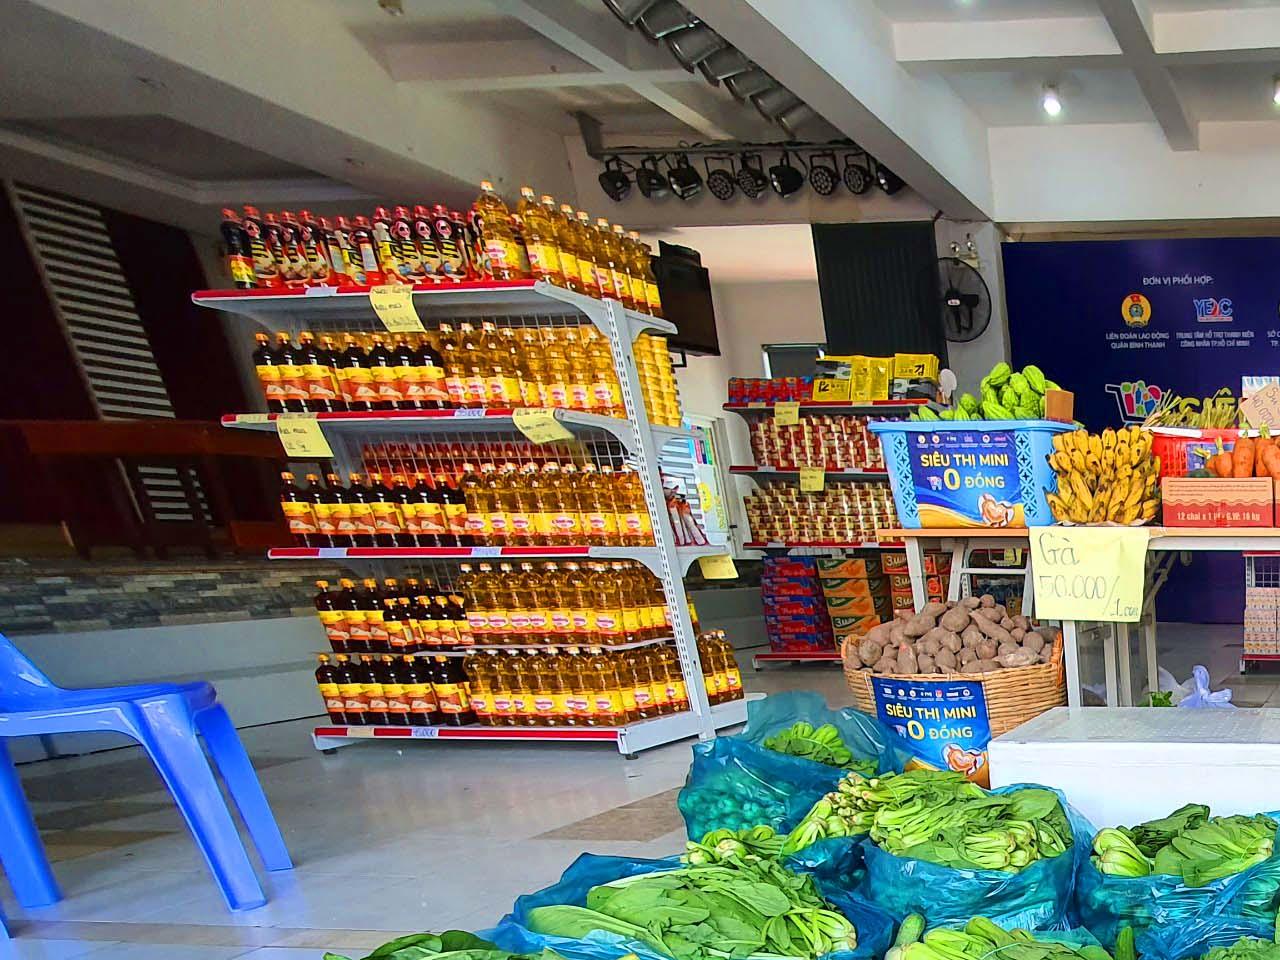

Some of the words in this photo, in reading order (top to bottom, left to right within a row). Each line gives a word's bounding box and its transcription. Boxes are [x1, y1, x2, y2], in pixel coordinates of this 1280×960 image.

[920, 451, 950, 467] SIÊU
[953, 453, 976, 470] THỊ
[980, 453, 1009, 467] MINI
[943, 468, 961, 490] 0
[965, 471, 1005, 489] ĐỒNG
[1039, 532, 1080, 567] Gà
[885, 701, 913, 718] SIÊU
[915, 707, 940, 722] THỊ
[944, 705, 977, 720] MINI
[907, 720, 925, 740] 0
[929, 724, 973, 740] ĐỒNG
